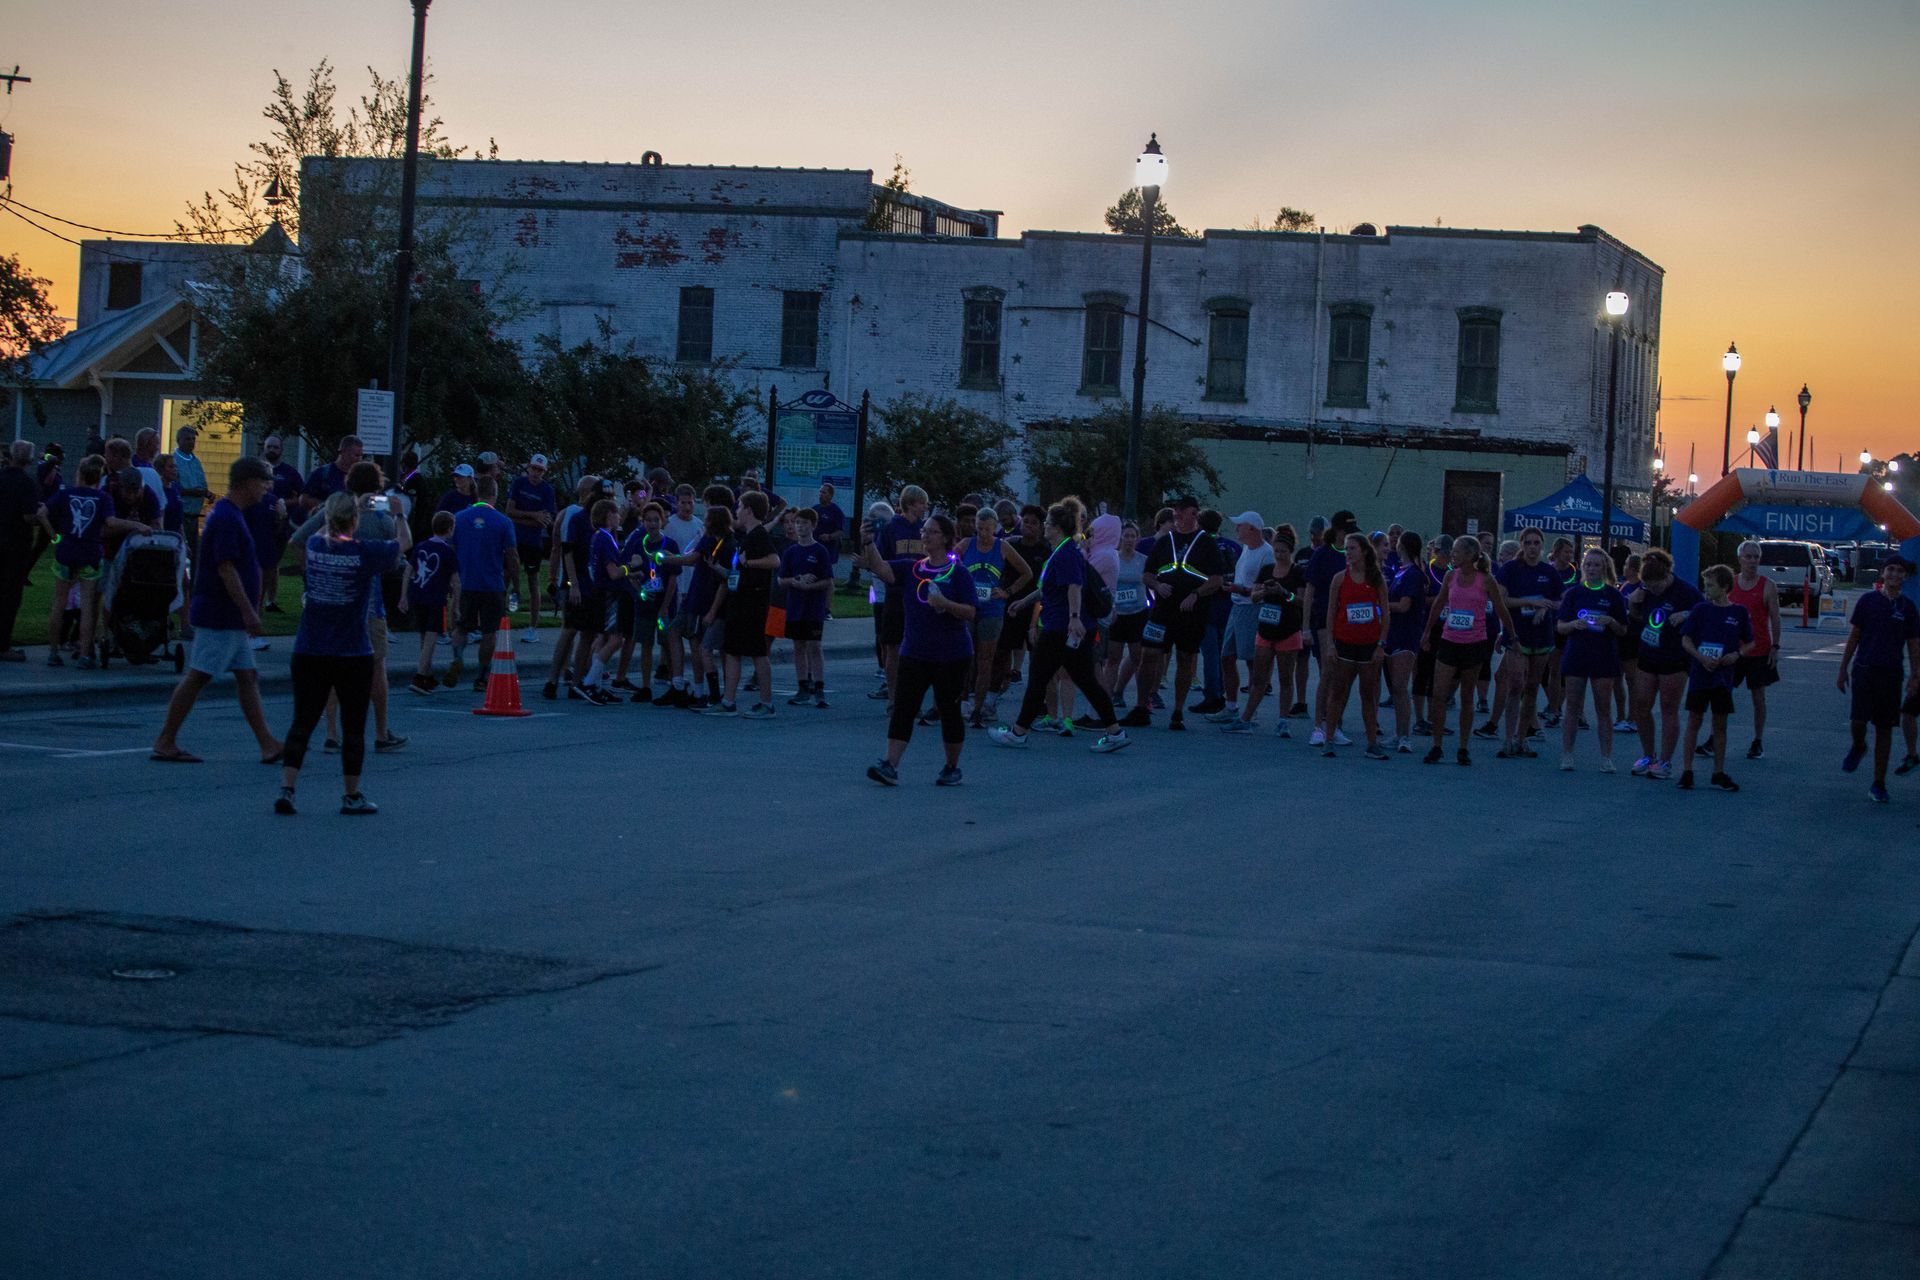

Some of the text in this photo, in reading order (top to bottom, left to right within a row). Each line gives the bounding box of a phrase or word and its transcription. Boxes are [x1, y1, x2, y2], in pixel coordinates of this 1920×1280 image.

[1780, 472, 1800, 483] Run
[1805, 474, 1820, 484] The
[1826, 475, 1847, 486] East
[1513, 513, 1634, 537] RunTheEast.om
[1766, 511, 1834, 533] FINISH
[1117, 590, 1134, 600] 2812
[1350, 609, 1370, 619] 2820
[1451, 615, 1470, 626] 2828
